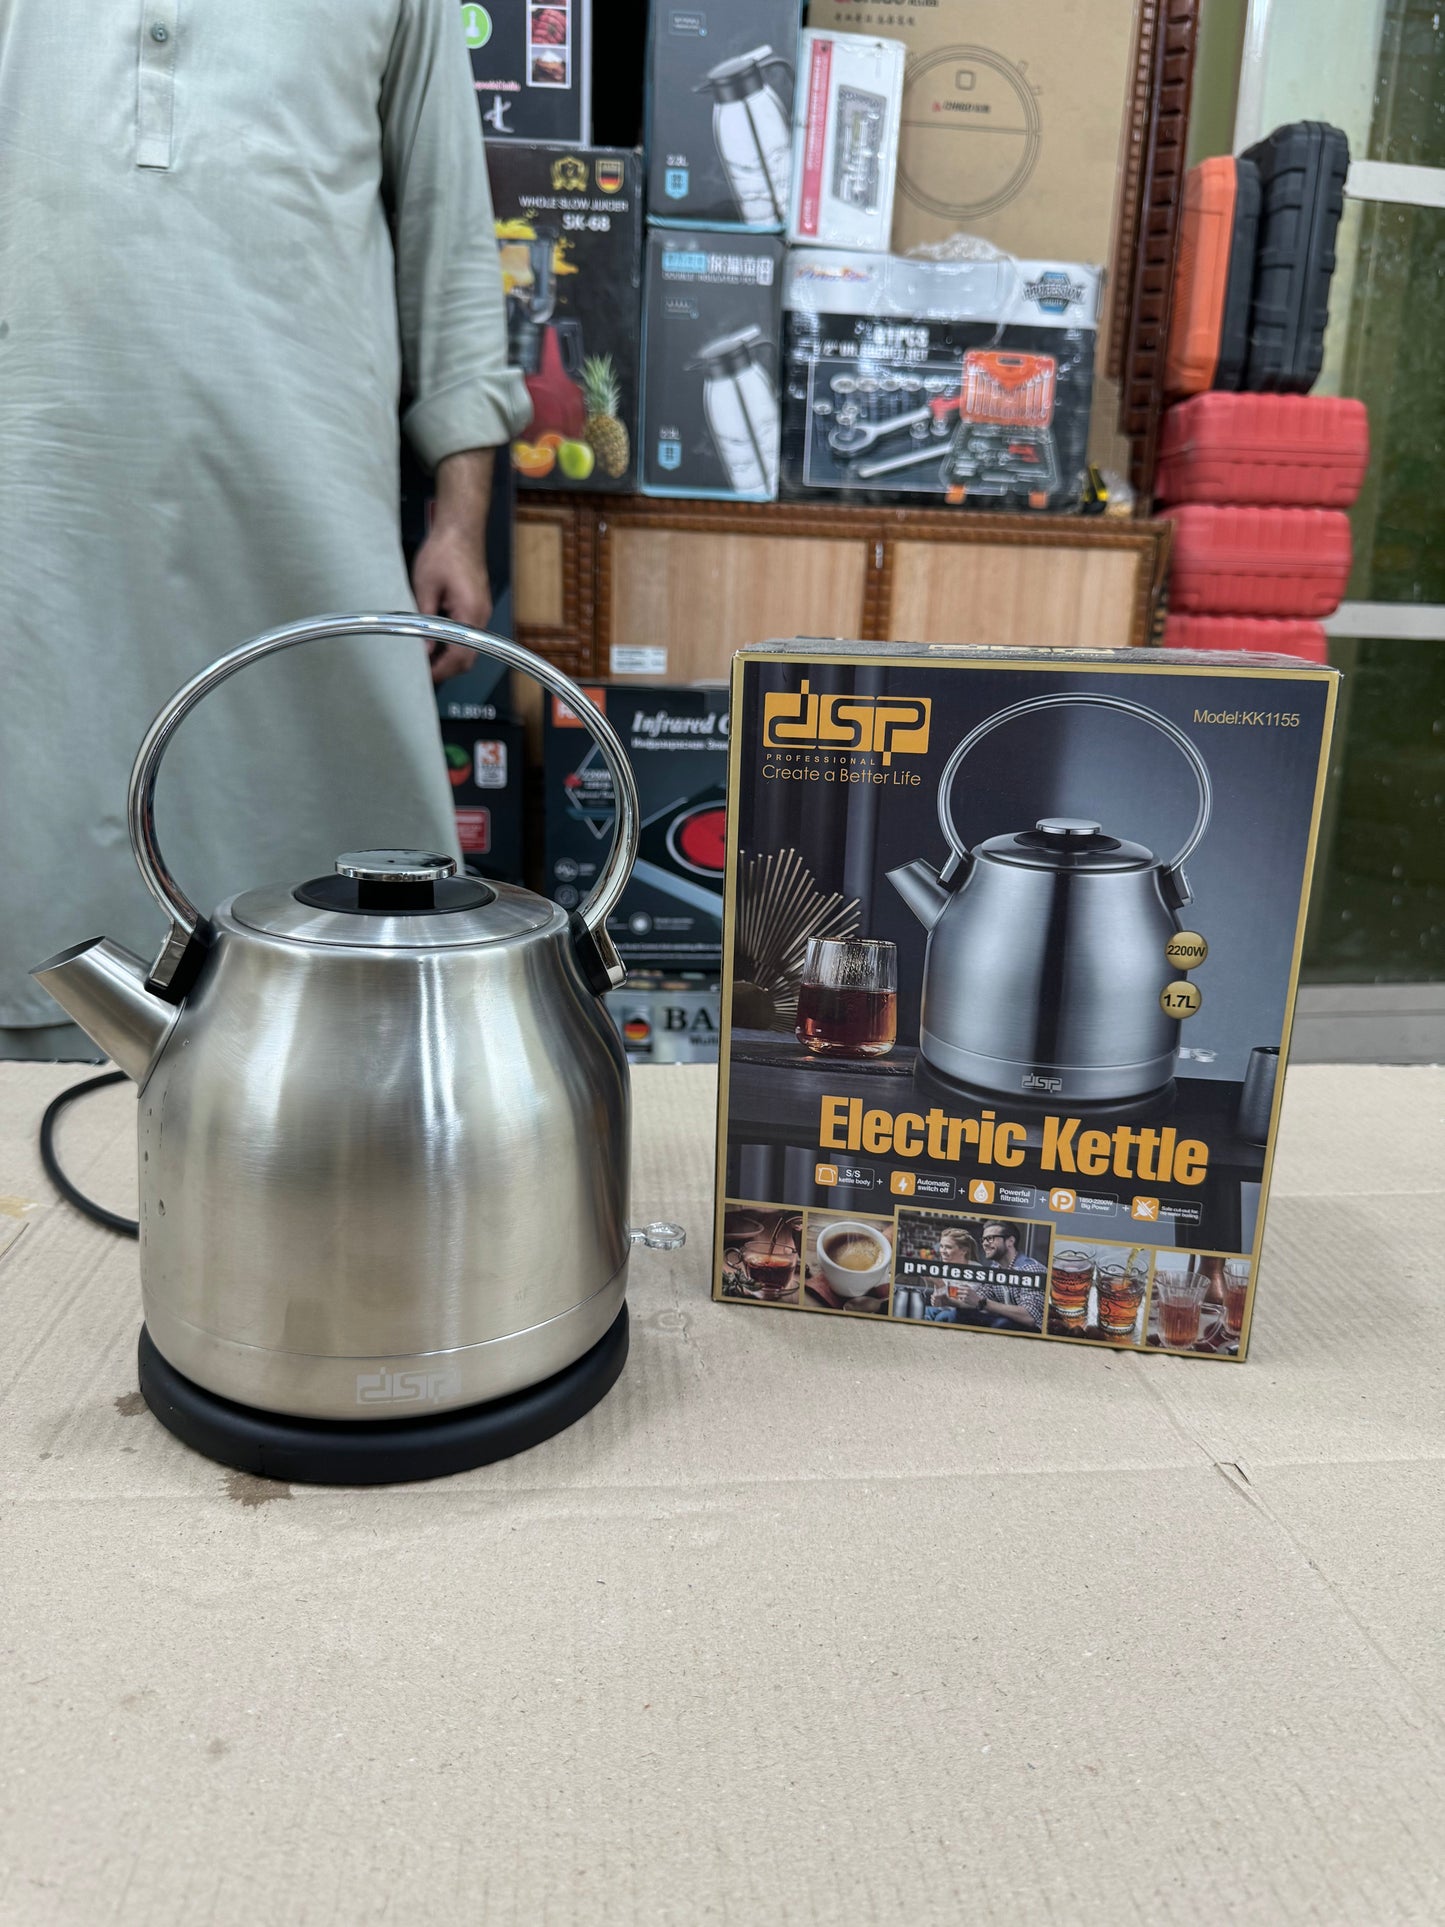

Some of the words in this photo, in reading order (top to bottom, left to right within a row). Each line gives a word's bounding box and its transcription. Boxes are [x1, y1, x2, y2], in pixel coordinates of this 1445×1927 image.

[631, 710, 716, 738] Infrared
[1193, 709, 1300, 728] Model:KK1155
[766, 753, 876, 766] PROFESSIONAL
[762, 764, 820, 781] Create
[824, 770, 835, 782] a
[839, 768, 889, 785] Better
[893, 770, 921, 786] Life
[1167, 945, 1206, 957] 2200W
[1163, 993, 1197, 1009] 1.7L
[819, 1095, 1027, 1168] Electric
[1040, 1115, 1209, 1186] Kettle
[845, 1169, 861, 1178] S/S
[838, 1177, 855, 1185] kettle
[855, 1178, 871, 1187] body
[917, 1178, 951, 1188] Automatic
[917, 1185, 939, 1193] switch
[999, 1187, 1031, 1197] Powerful
[1000, 1195, 1029, 1204] filtration
[1081, 1203, 1091, 1211] Big
[903, 1261, 1040, 1287] professional
